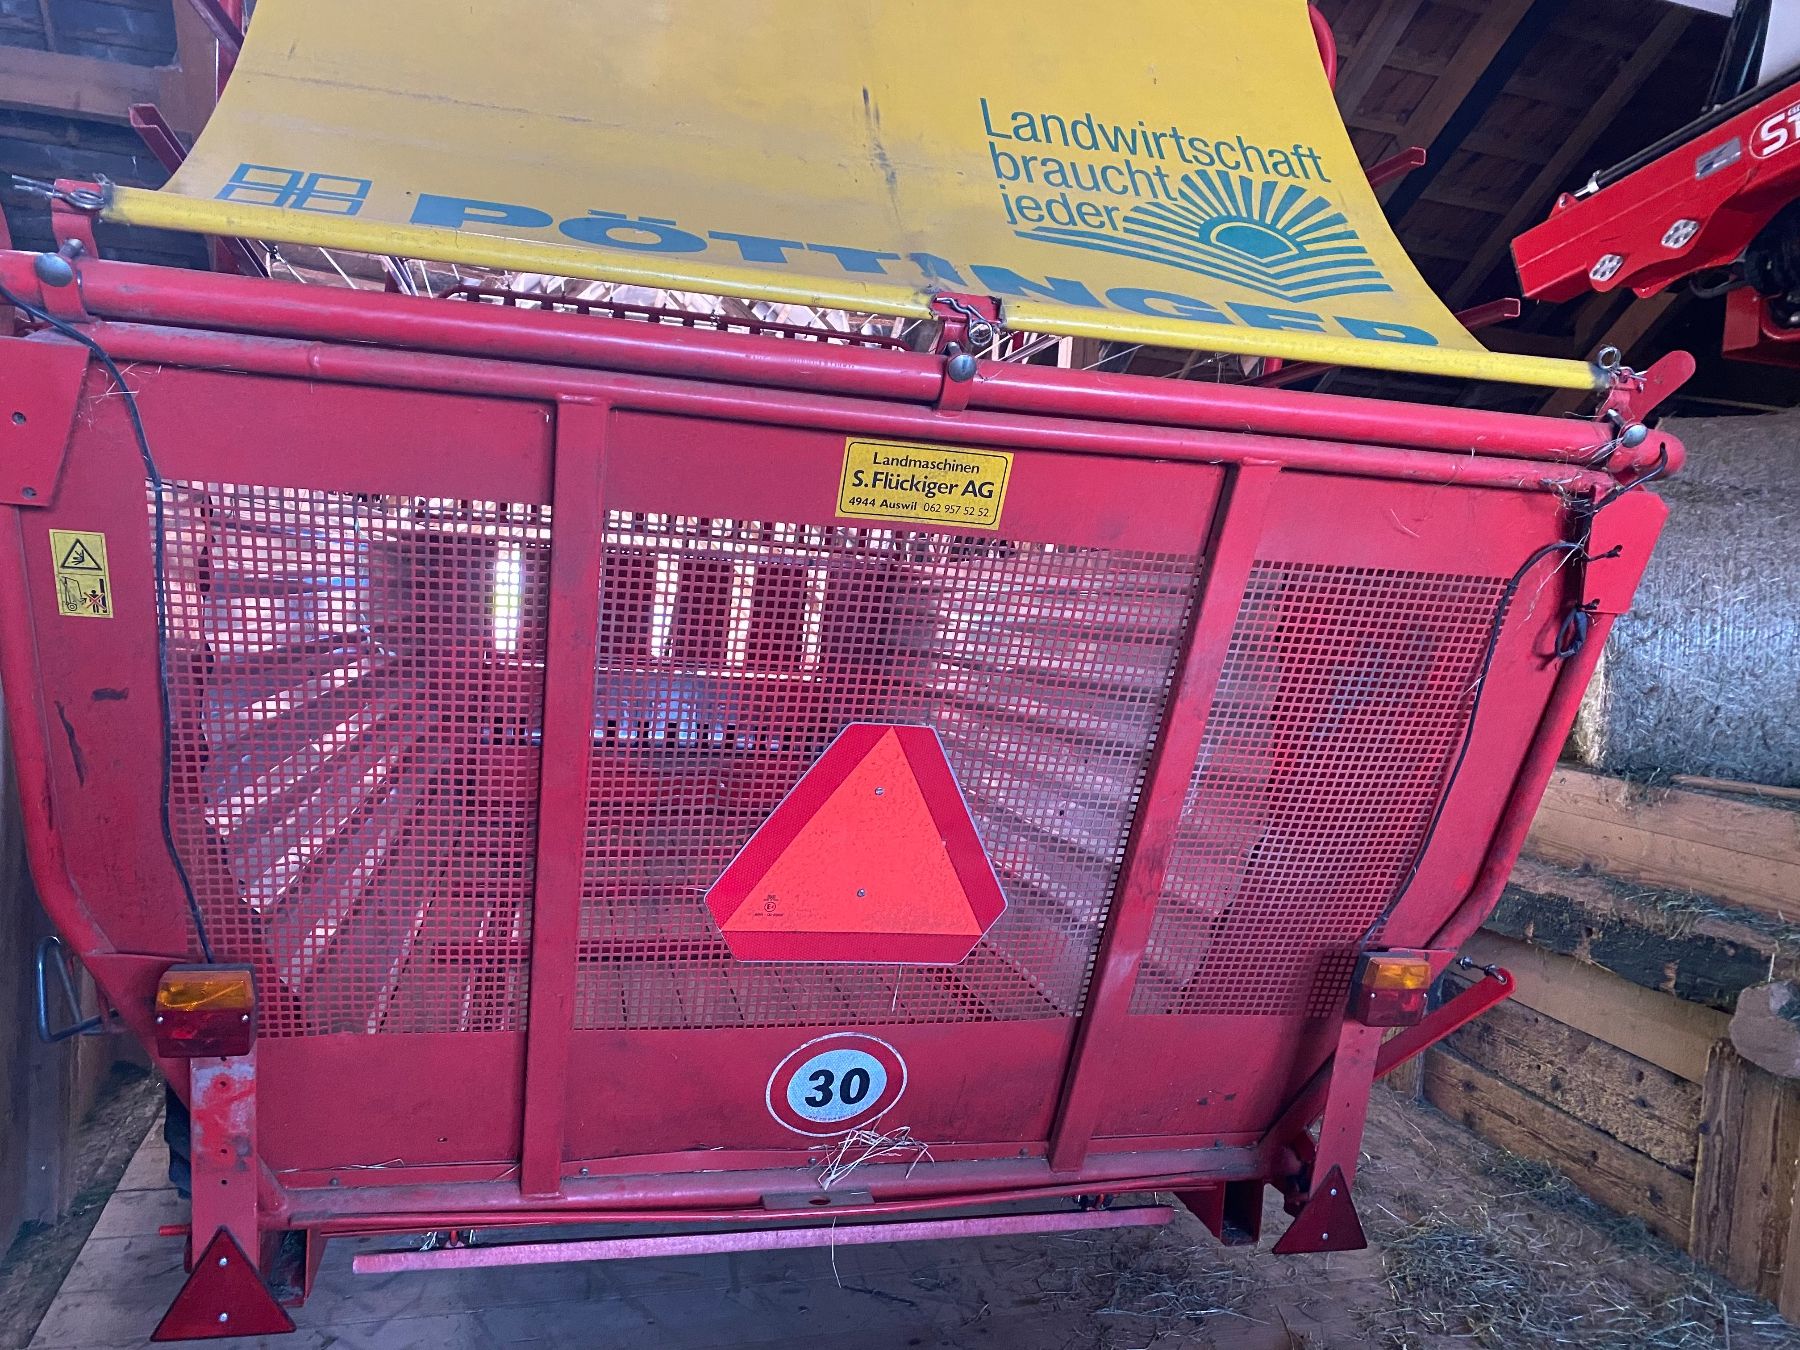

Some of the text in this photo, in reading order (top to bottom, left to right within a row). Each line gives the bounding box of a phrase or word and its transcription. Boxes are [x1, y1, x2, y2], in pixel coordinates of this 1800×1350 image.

[979, 97, 1331, 184] Landwirtschaft
[989, 141, 1178, 202] braucht
[1000, 184, 1122, 232] jeder
[873, 452, 980, 474] Landmaschinen
[871, 471, 959, 499] Flückiger
[961, 479, 995, 499] AG
[848, 496, 990, 517] 4944 Auswil 062 957 52 52
[804, 1067, 870, 1108] 30
